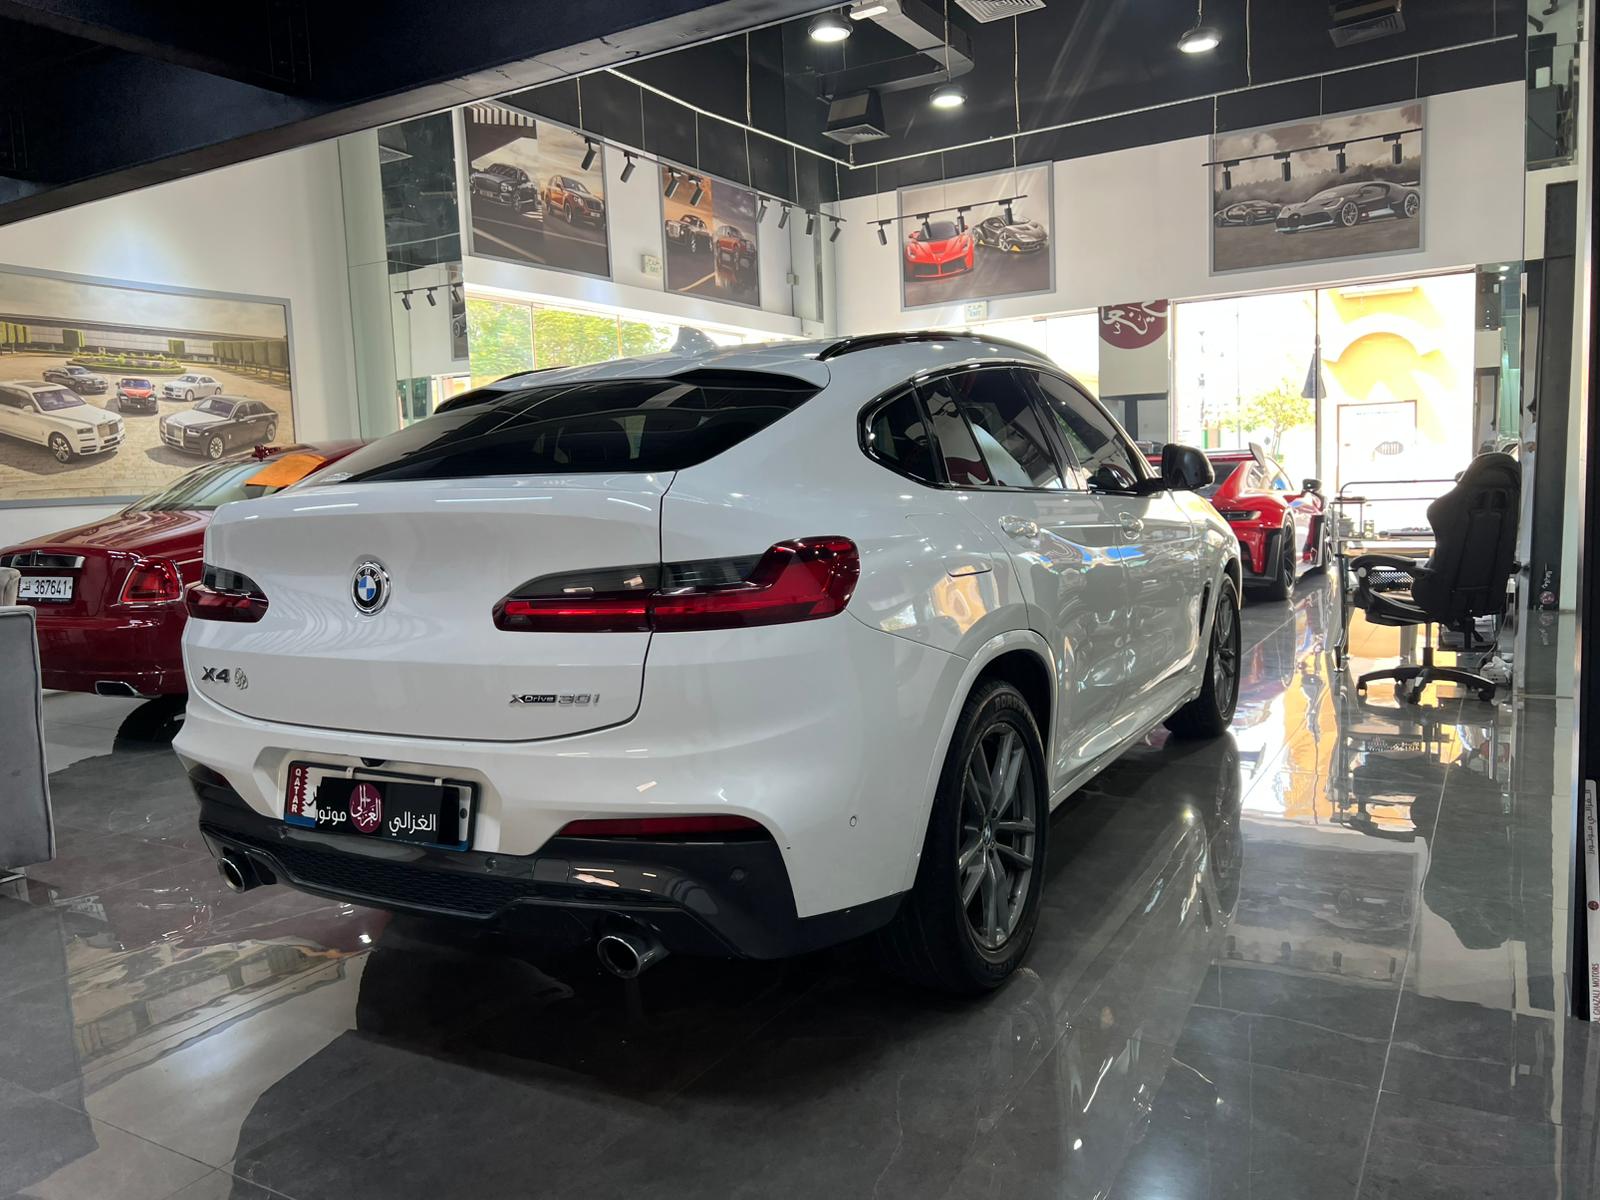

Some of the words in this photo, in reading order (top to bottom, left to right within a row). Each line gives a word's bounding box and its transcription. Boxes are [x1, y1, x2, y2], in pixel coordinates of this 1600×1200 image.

[35, 579, 67, 595] 367641
[201, 666, 230, 683] X4
[291, 768, 302, 813] QATAR
[388, 811, 437, 836] الغزالي
